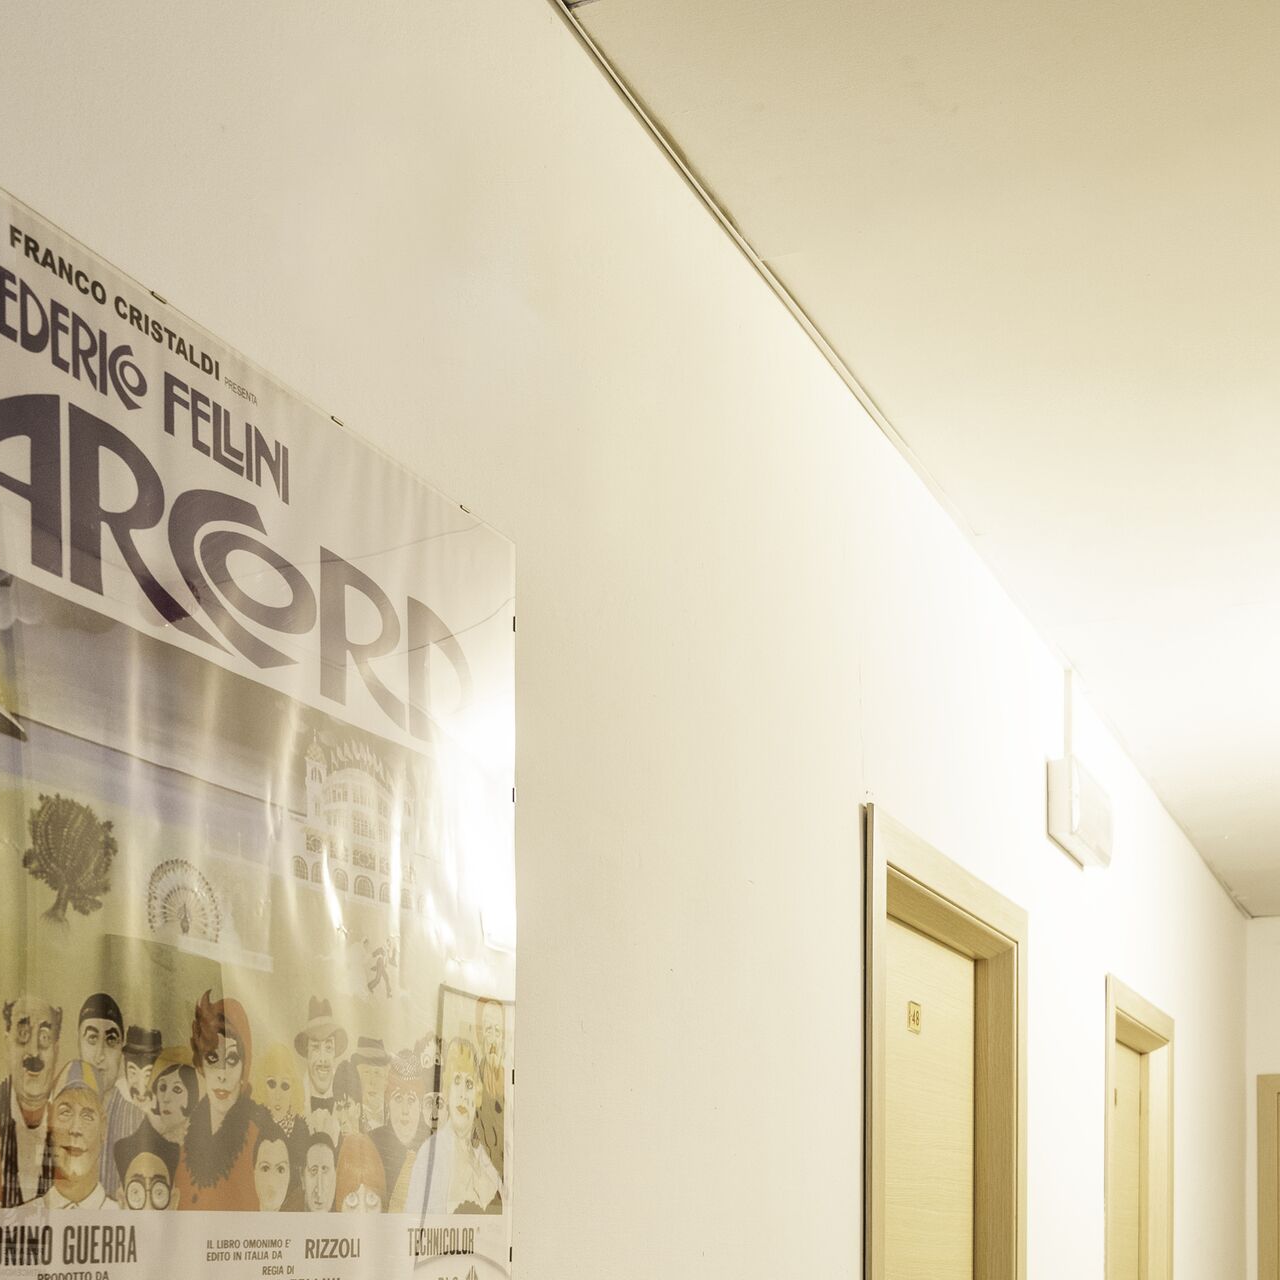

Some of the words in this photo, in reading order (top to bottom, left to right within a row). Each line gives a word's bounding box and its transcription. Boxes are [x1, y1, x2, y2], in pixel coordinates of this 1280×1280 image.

[9, 224, 107, 305] FRANCO
[114, 295, 221, 381] CRISTALDI
[223, 376, 258, 406] PRESENTA
[163, 370, 290, 506] FELLINI
[62, 1224, 138, 1265] GUERRA
[206, 1239, 214, 1249] IL
[216, 1239, 241, 1250] LIBRO
[243, 1239, 283, 1249] OMONIMO
[304, 1237, 361, 1259] RIZZOLI
[408, 1226, 475, 1256] TECHNICOLOR
[206, 1251, 231, 1262] EDITO
[233, 1251, 242, 1261] IN
[244, 1250, 269, 1261] ITALIA
[272, 1250, 283, 1260] DA
[262, 1265, 285, 1276] REGIA
[286, 1264, 295, 1275] DI
